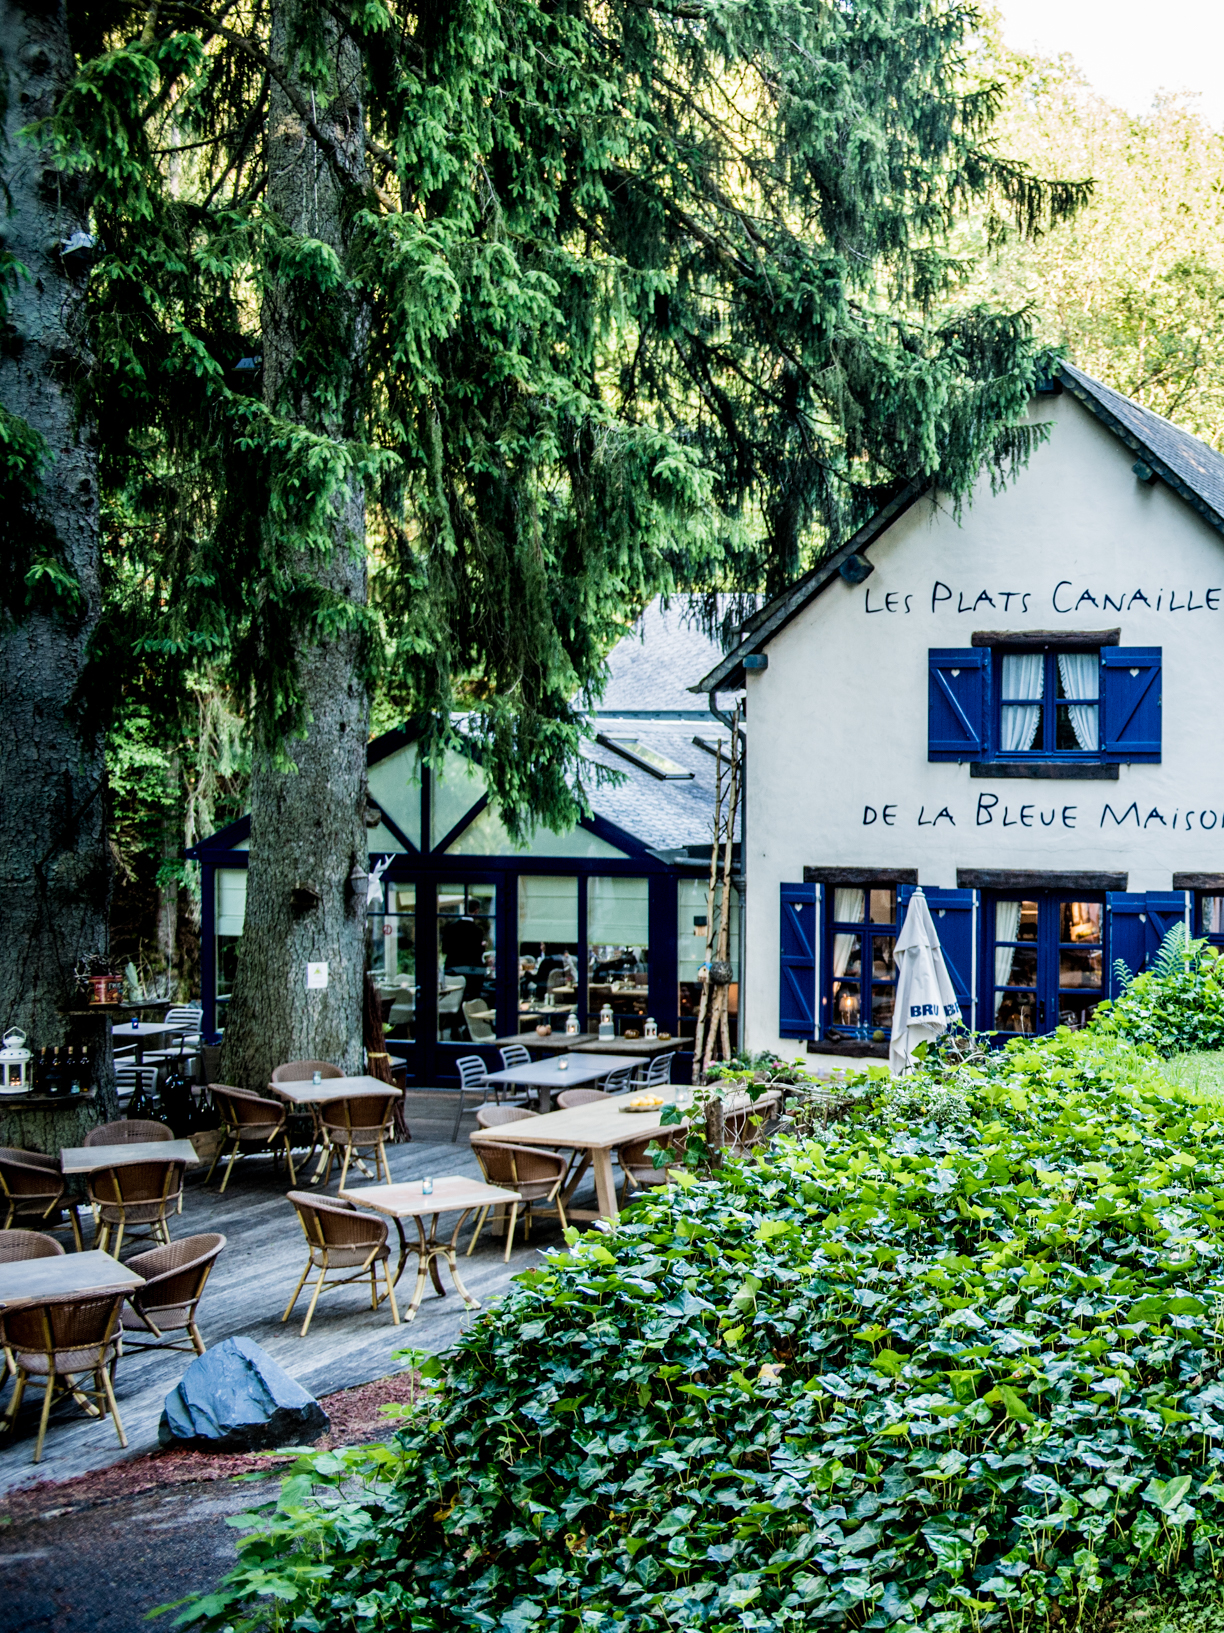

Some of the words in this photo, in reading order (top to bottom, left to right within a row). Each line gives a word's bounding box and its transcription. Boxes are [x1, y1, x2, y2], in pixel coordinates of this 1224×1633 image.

[865, 588, 913, 614] LES
[931, 580, 1033, 614] PLATS
[862, 804, 899, 826] DE
[917, 805, 957, 828] LA
[976, 792, 1078, 829] BLEUE
